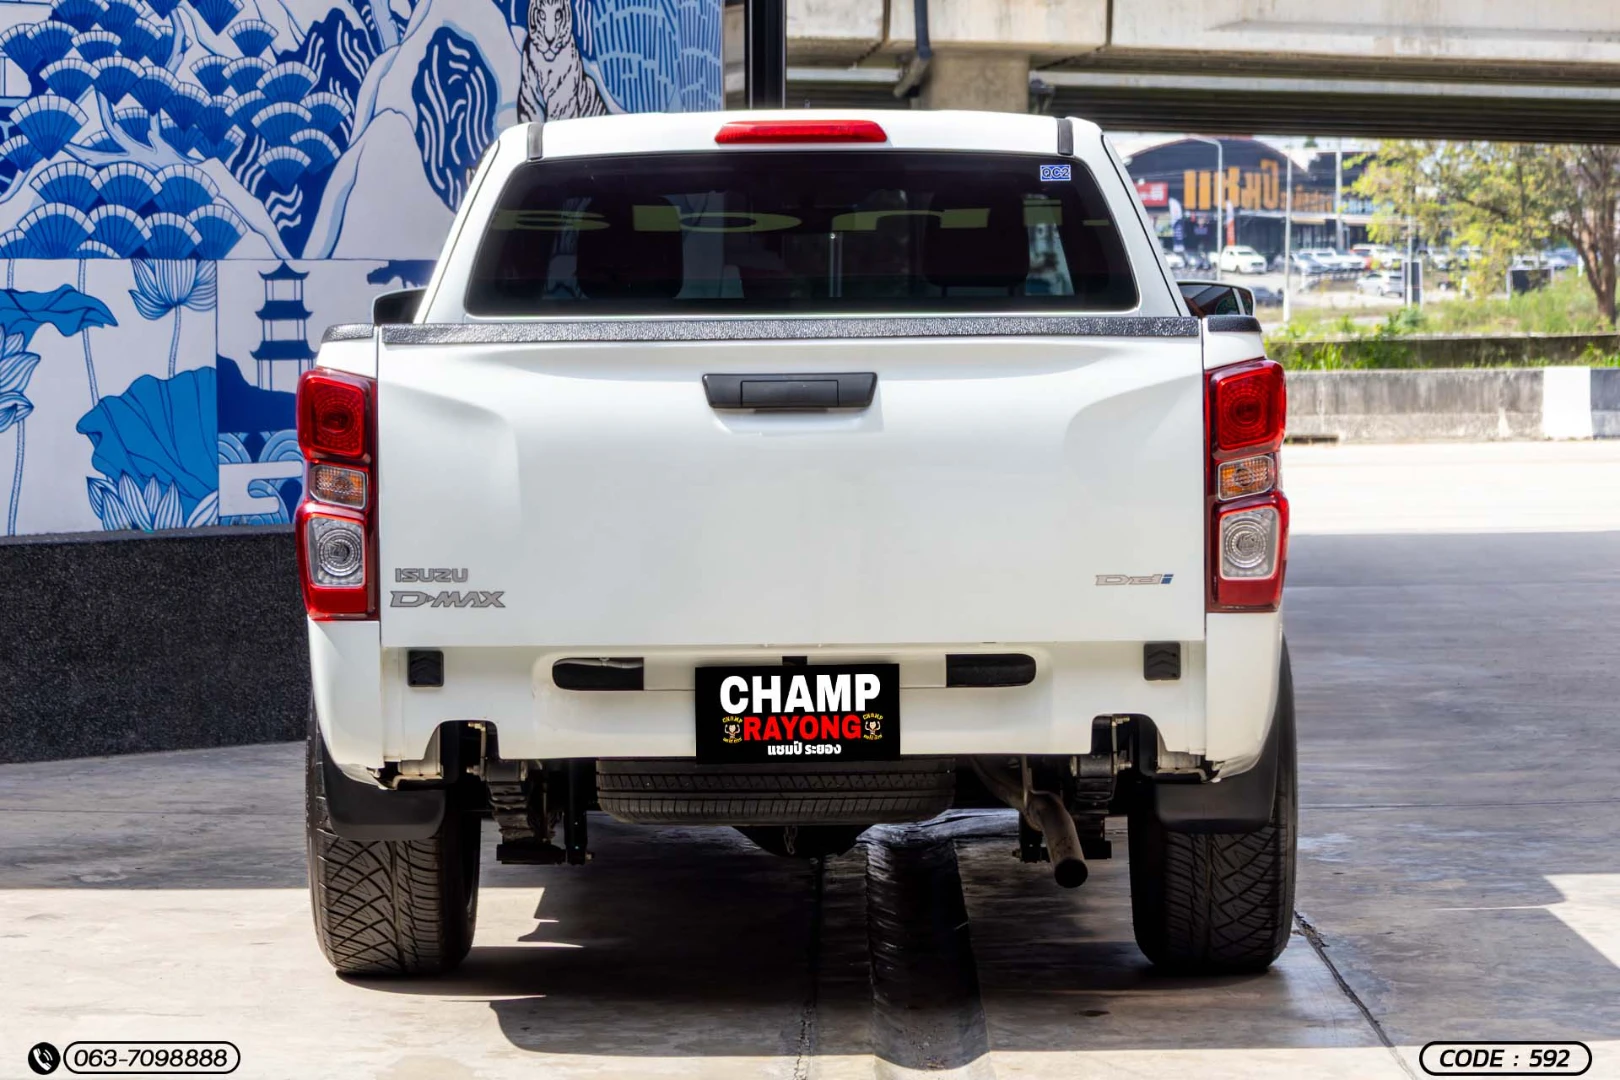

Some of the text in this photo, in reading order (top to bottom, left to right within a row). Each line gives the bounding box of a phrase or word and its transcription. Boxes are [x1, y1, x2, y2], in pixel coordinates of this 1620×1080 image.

[1041, 166, 1070, 179] QC2
[395, 568, 468, 582] ISUZU
[390, 591, 505, 607] D-MAX
